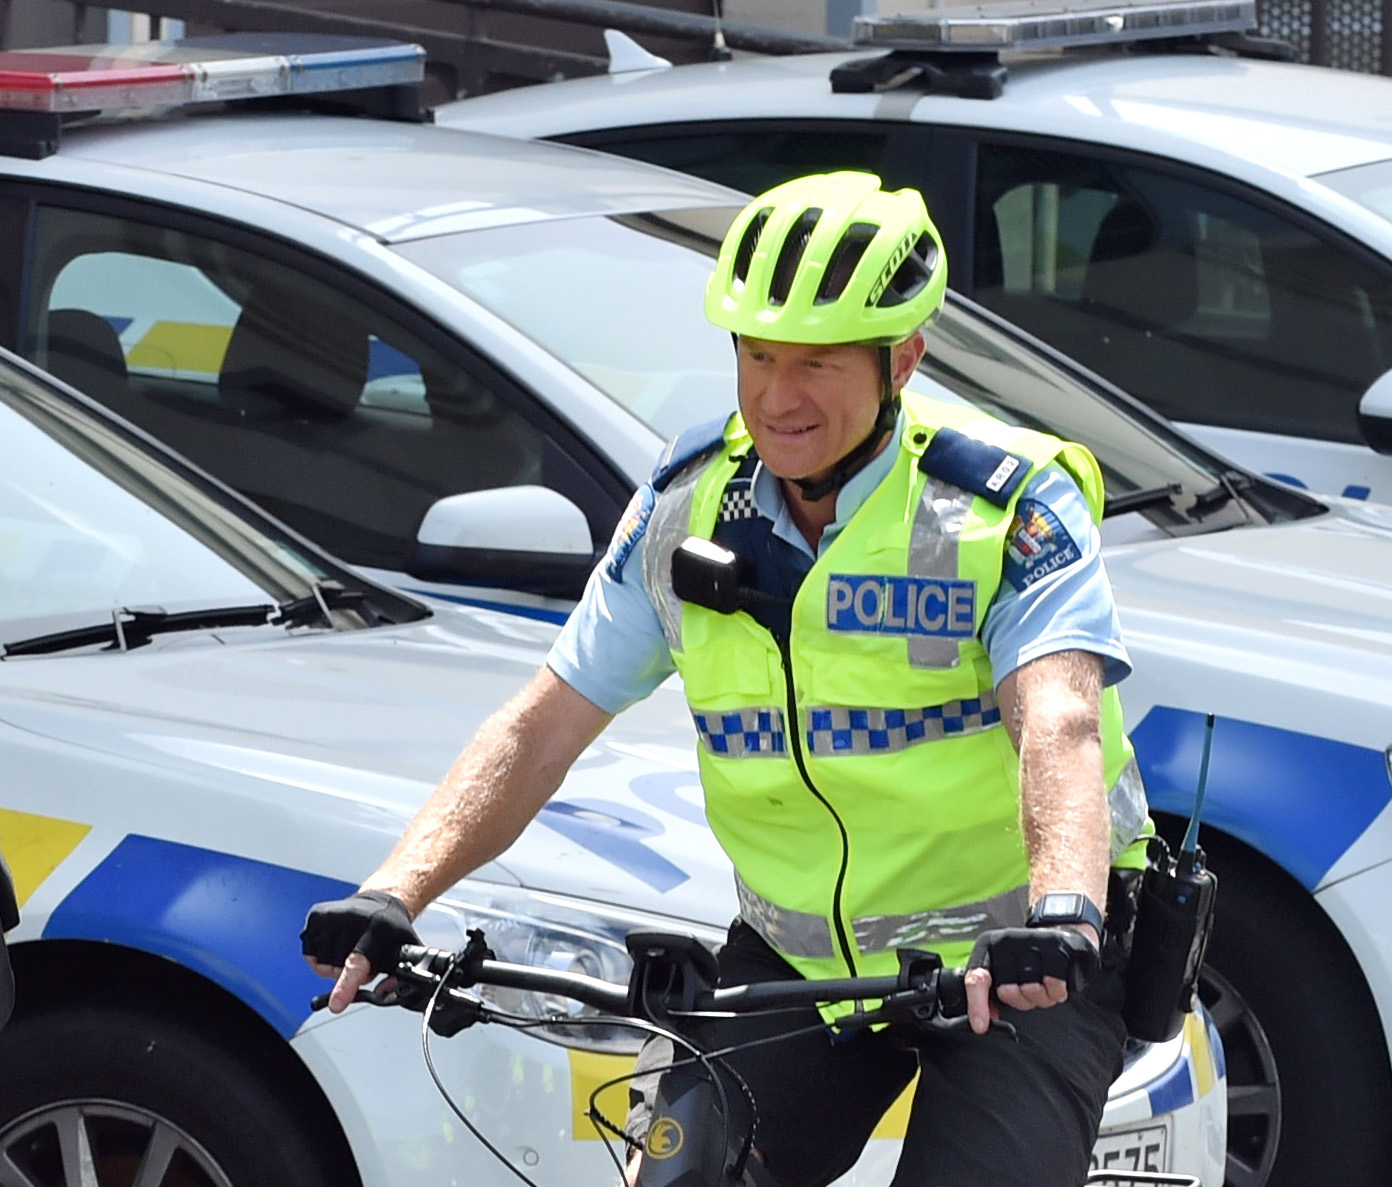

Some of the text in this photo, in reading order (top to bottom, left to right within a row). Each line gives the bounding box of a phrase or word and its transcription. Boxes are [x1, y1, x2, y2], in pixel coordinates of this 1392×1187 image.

[868, 231, 917, 305] SCOTT
[1023, 544, 1075, 586] POLICE
[827, 580, 974, 632] POLICE
